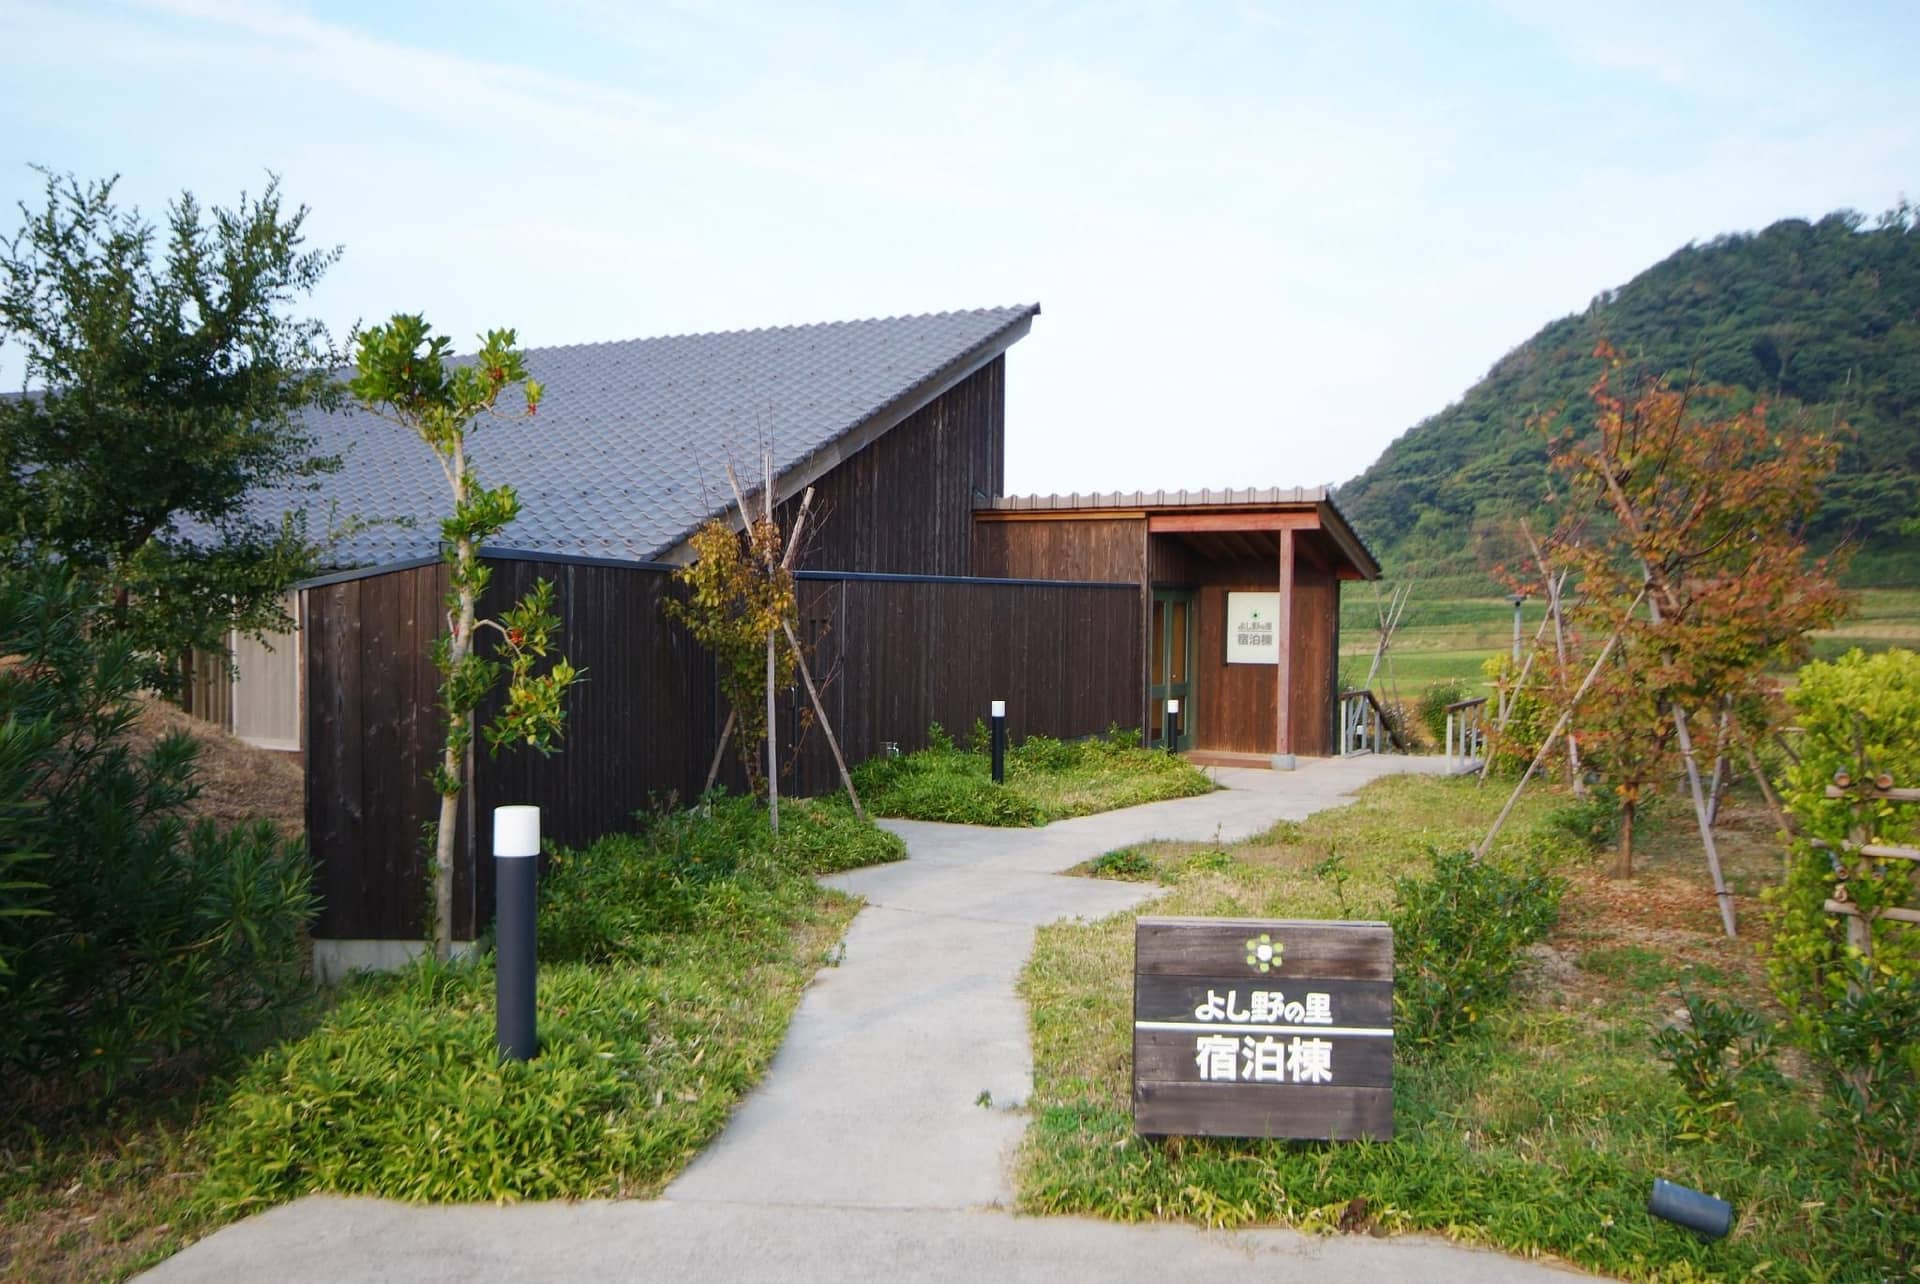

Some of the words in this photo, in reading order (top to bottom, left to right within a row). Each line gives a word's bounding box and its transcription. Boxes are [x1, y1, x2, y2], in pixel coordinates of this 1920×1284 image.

[1195, 990, 1333, 1024] よし野の里
[1195, 1034, 1333, 1083] 宿泊棟
